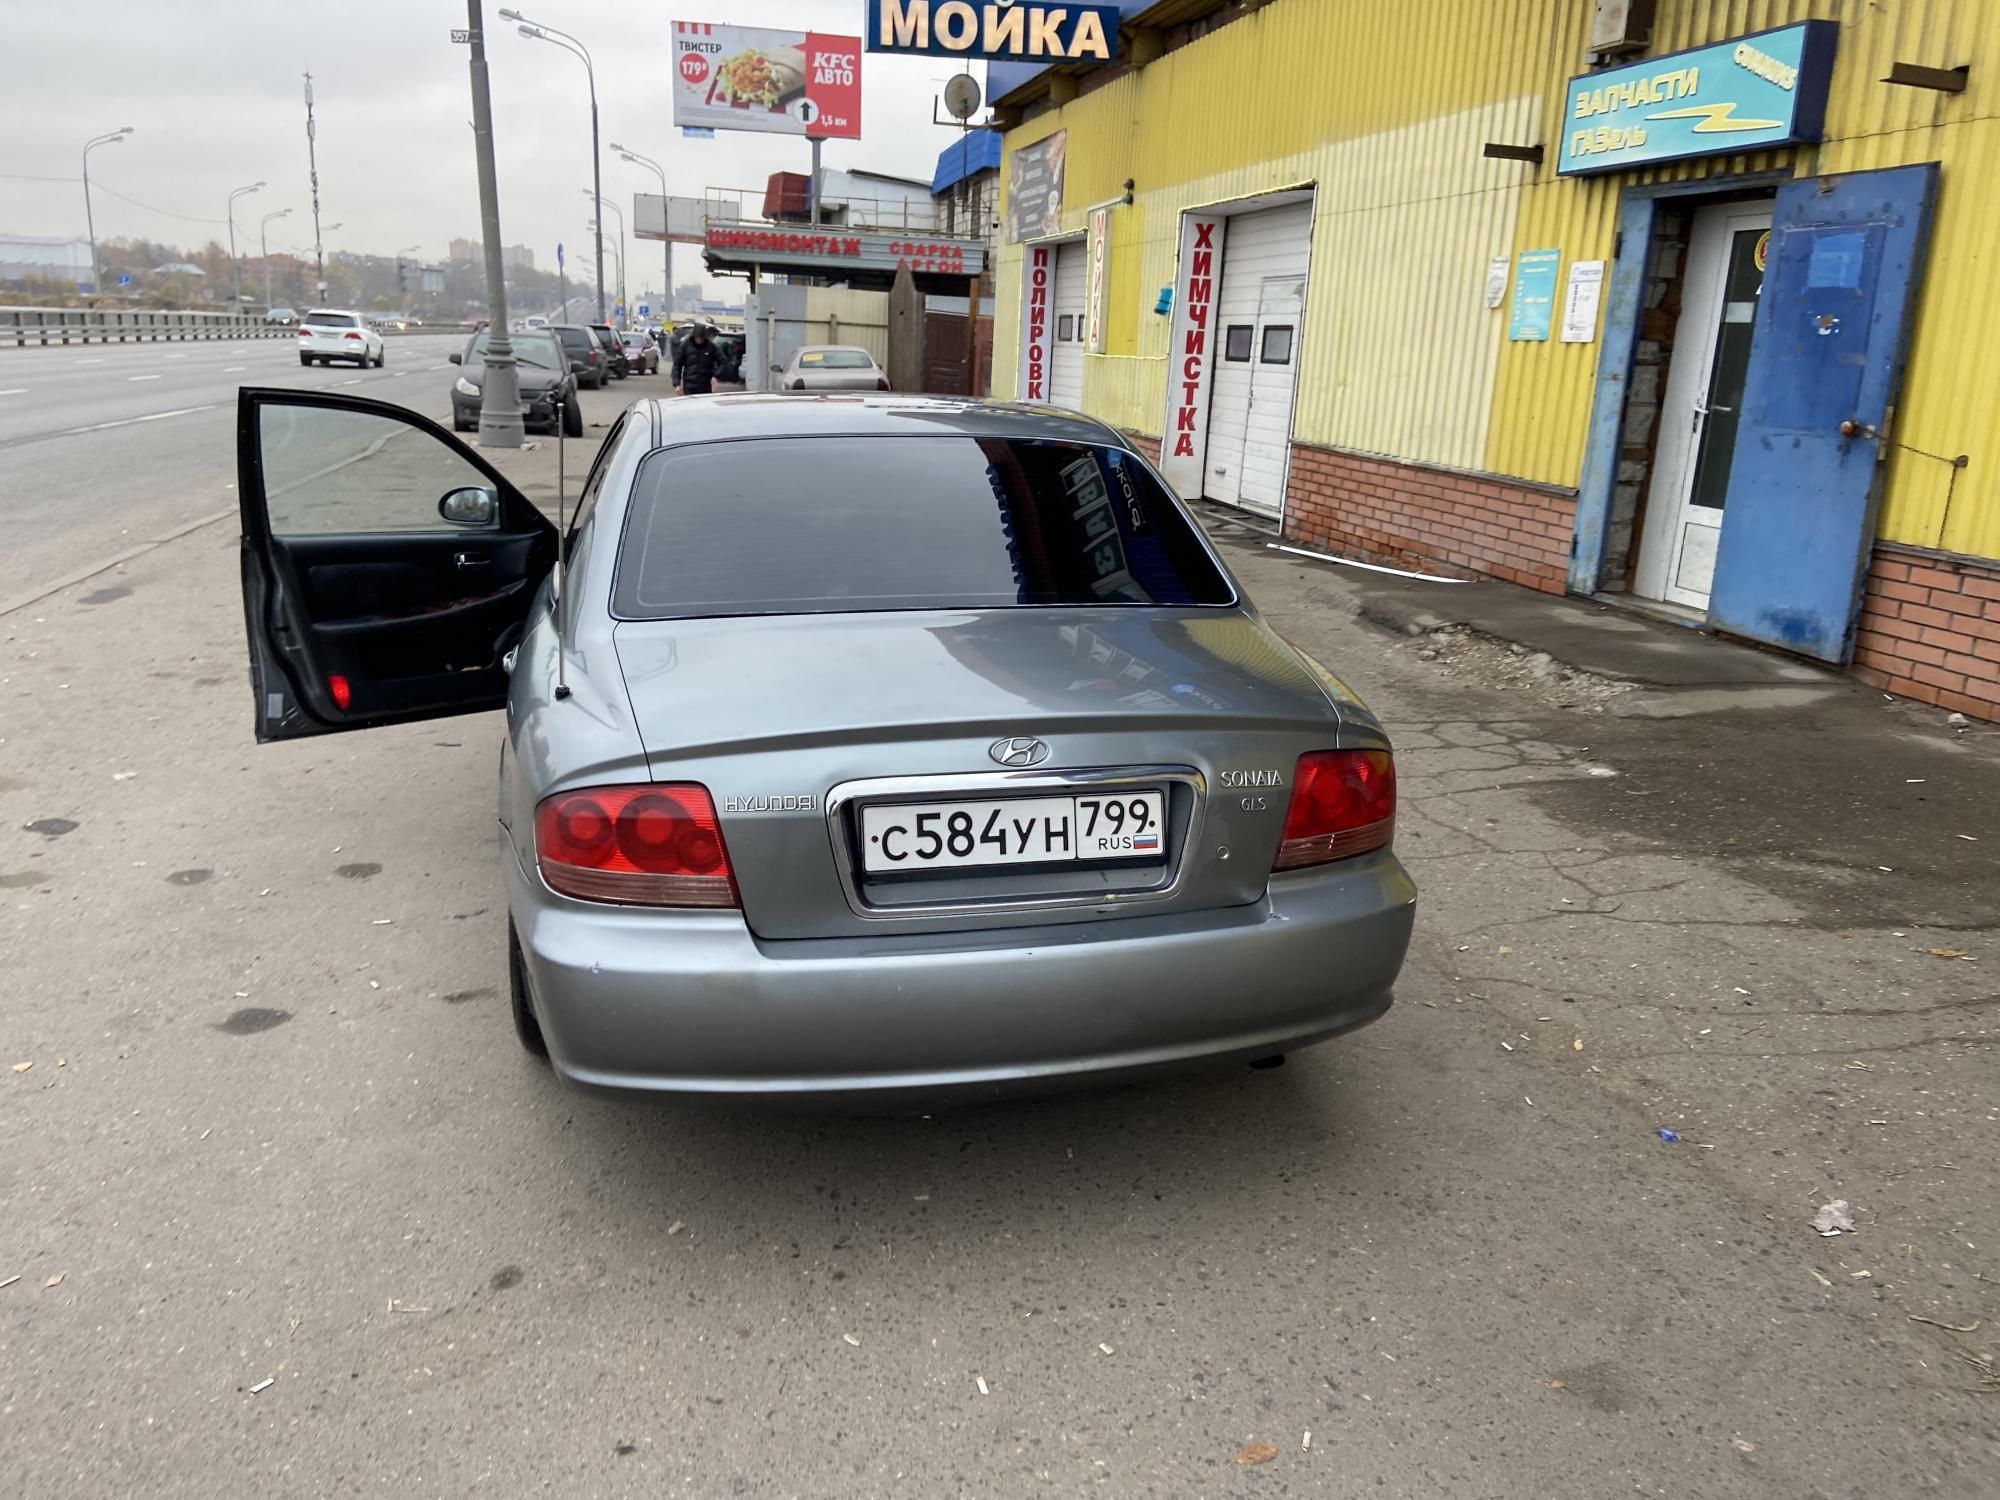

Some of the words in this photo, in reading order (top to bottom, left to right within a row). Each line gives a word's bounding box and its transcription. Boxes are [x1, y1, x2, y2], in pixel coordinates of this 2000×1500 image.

[880, 0, 1110, 59] МОЙКА
[679, 41, 722, 53] ТВИСТЕР
[812, 52, 855, 69] KFC
[814, 68, 853, 86] АВТО
[1575, 67, 1700, 119] ЗАПЧАСТИ
[821, 114, 833, 127] 1,5
[708, 229, 862, 256] ШИНОМОНТАЖ
[889, 241, 963, 259] СВАРКА
[1090, 211, 1105, 342] МОЙКА
[1173, 223, 1216, 457] ХИМЧИСТКА
[1220, 769, 1285, 788] SONATA
[723, 794, 818, 813] HYUNDAI
[1241, 797, 1267, 811] GLS
[1079, 799, 1149, 838] 799
[1098, 837, 1132, 850] RUS
